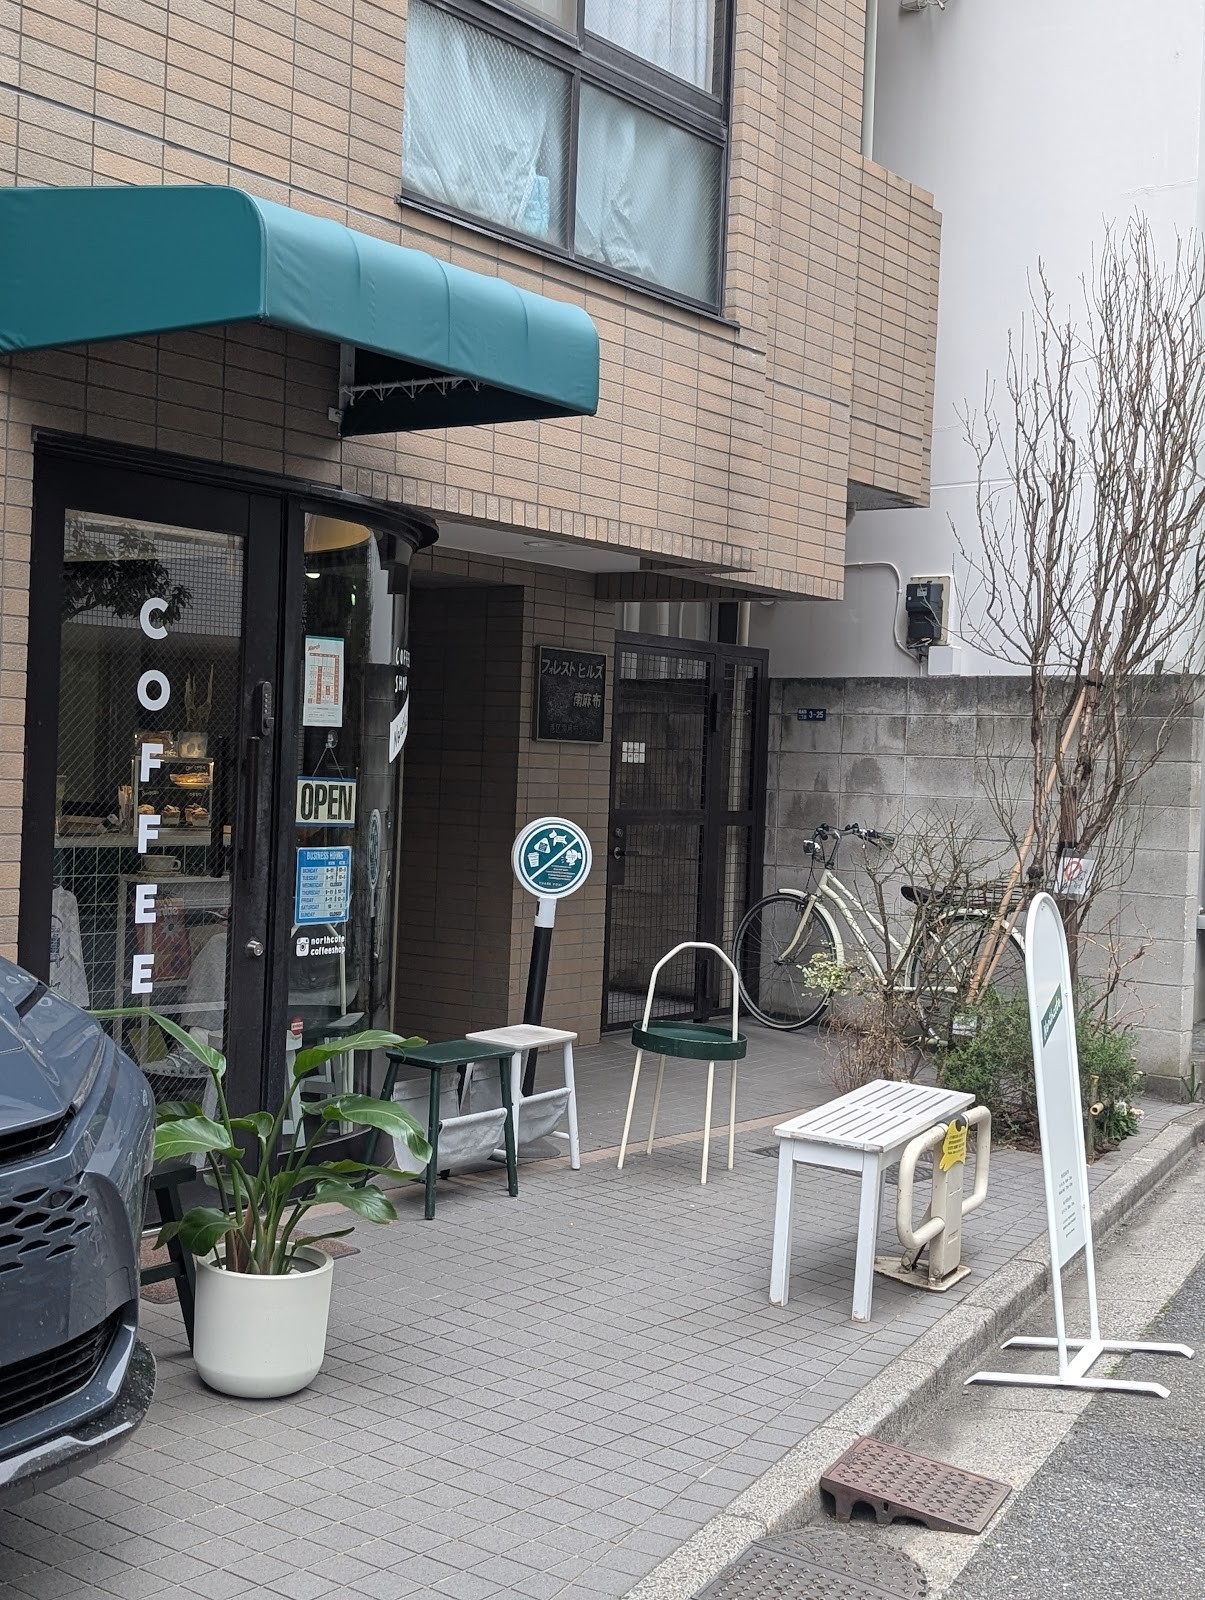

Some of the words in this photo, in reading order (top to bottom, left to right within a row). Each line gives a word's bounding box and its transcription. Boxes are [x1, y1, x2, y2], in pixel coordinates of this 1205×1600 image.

[542, 658, 576, 678] フォレスト
[578, 663, 605, 682] ヒルズ
[573, 691, 602, 709] 南麻布
[809, 711, 823, 719] 3-25
[132, 597, 170, 995] COFFEE
[301, 782, 352, 822] OPEN
[306, 851, 329, 861] BUSINESS
[329, 851, 344, 860] HOURS
[310, 946, 346, 956] coffeeshop
